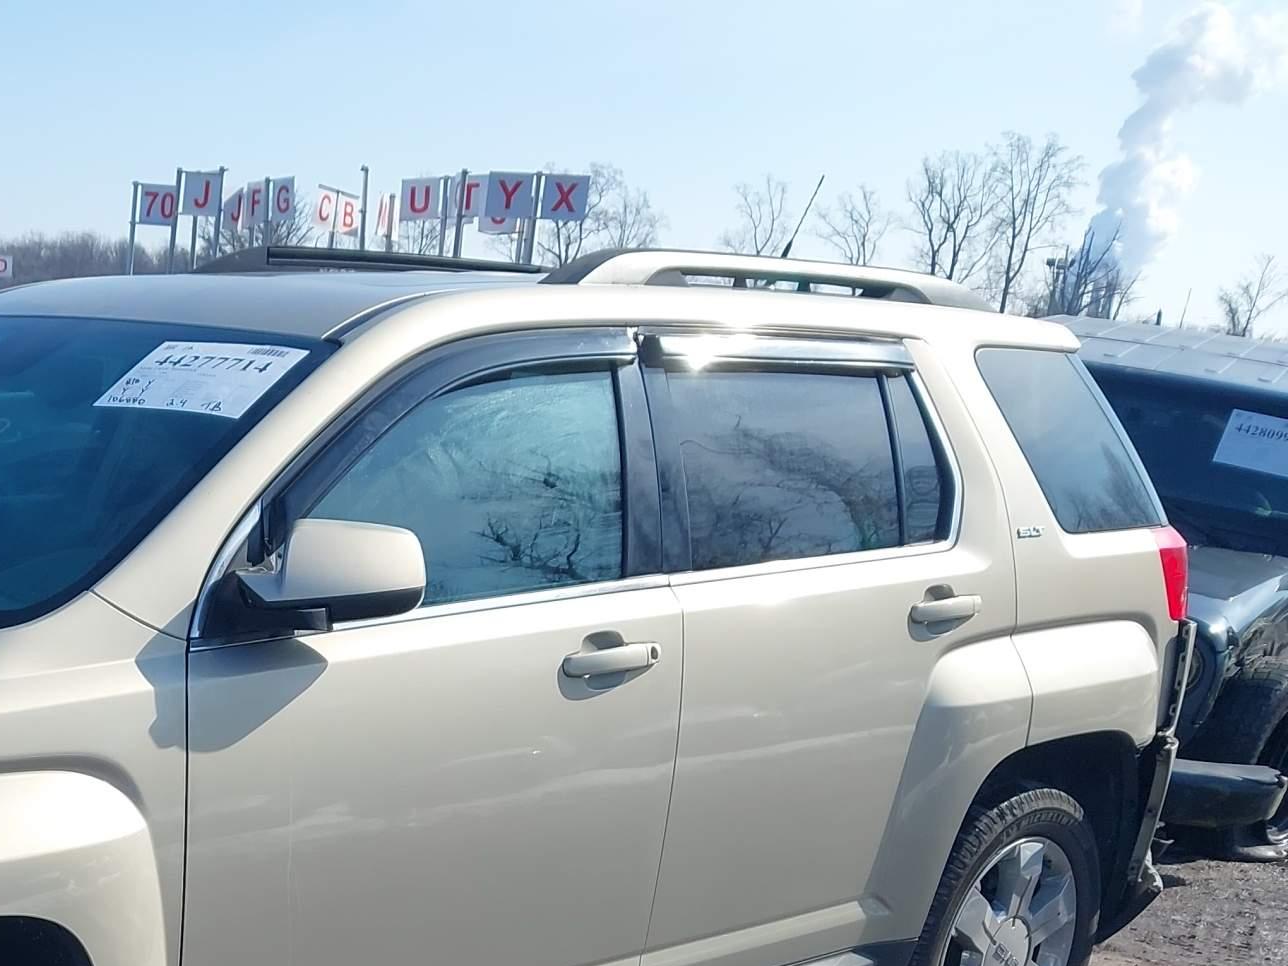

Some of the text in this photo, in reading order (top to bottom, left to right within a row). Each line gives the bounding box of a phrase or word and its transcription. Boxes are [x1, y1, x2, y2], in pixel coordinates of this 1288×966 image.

[144, 191, 175, 218] 70
[194, 180, 211, 208] J
[231, 194, 242, 222] J
[251, 189, 261, 217] F
[276, 185, 290, 214] G
[318, 194, 331, 222] C
[410, 185, 431, 214] U
[499, 179, 523, 210] Y
[551, 182, 578, 213] X
[343, 201, 354, 228] B
[155, 354, 272, 374] 44277714
